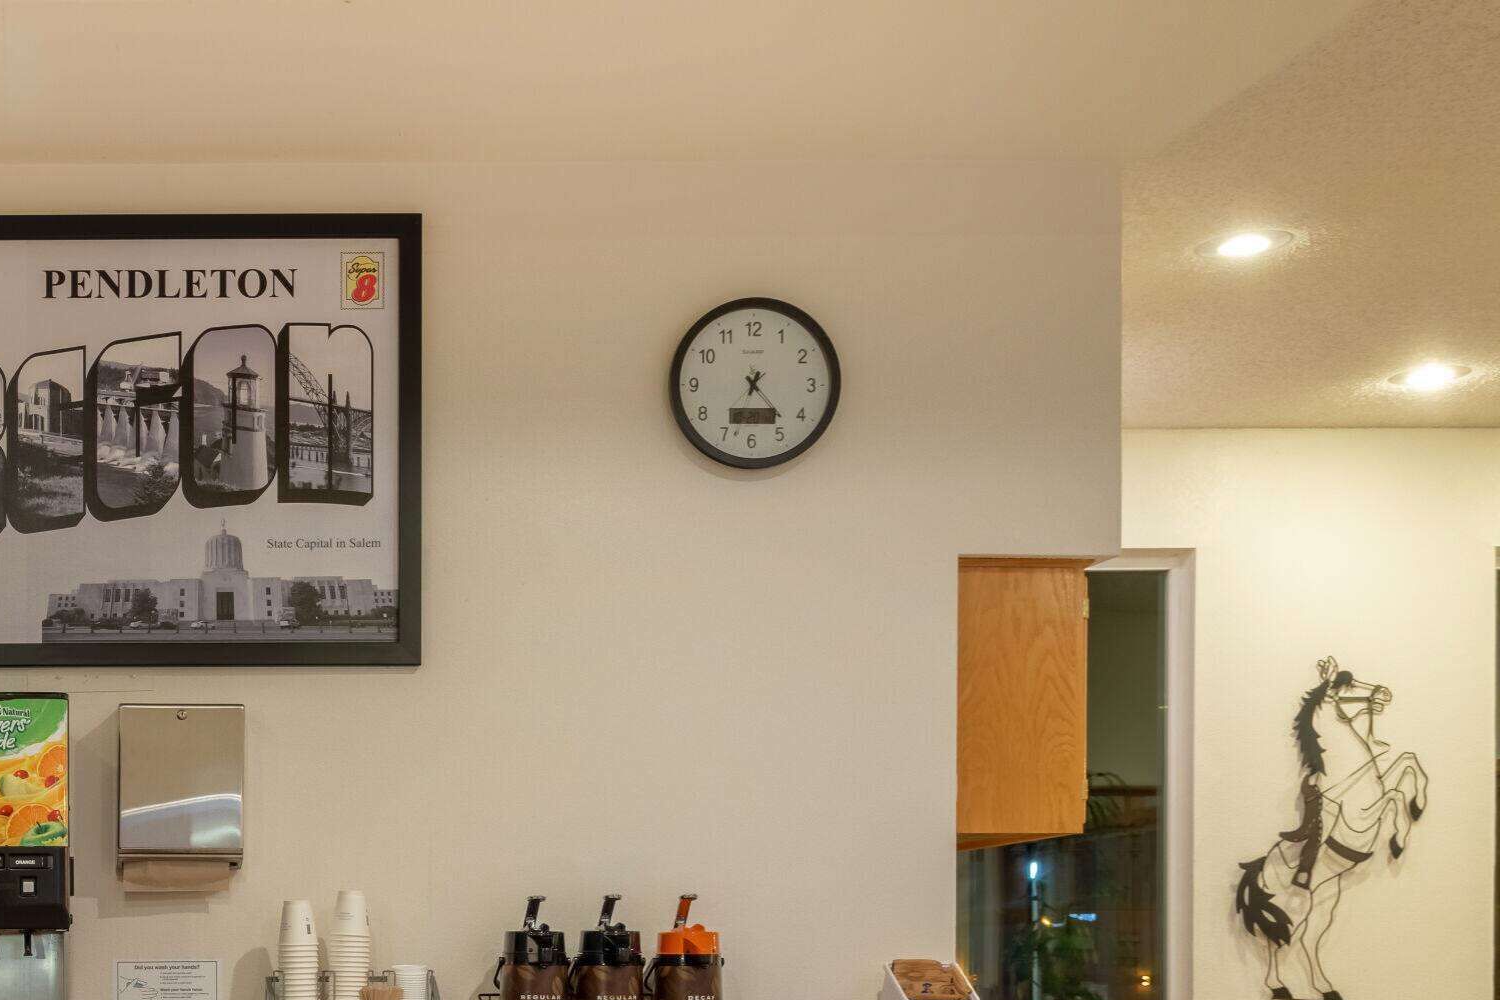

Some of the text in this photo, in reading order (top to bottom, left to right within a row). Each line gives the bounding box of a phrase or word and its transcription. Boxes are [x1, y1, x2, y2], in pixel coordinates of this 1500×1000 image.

[41, 268, 298, 299] PENDLETON
[351, 273, 377, 302] 8
[718, 329, 733, 344] 11
[744, 321, 763, 337] 12
[777, 329, 785, 344] 1
[699, 349, 716, 364] 10
[797, 348, 808, 364] 2
[689, 377, 700, 393] 9
[806, 377, 817, 393] 3
[698, 405, 708, 421] 8
[796, 407, 806, 422] 4
[719, 427, 729, 442] 7
[746, 433, 757, 449] 6
[775, 427, 785, 442] 5
[266, 538, 381, 550] State Capital in Salem
[3, 708, 31, 718] Natural
